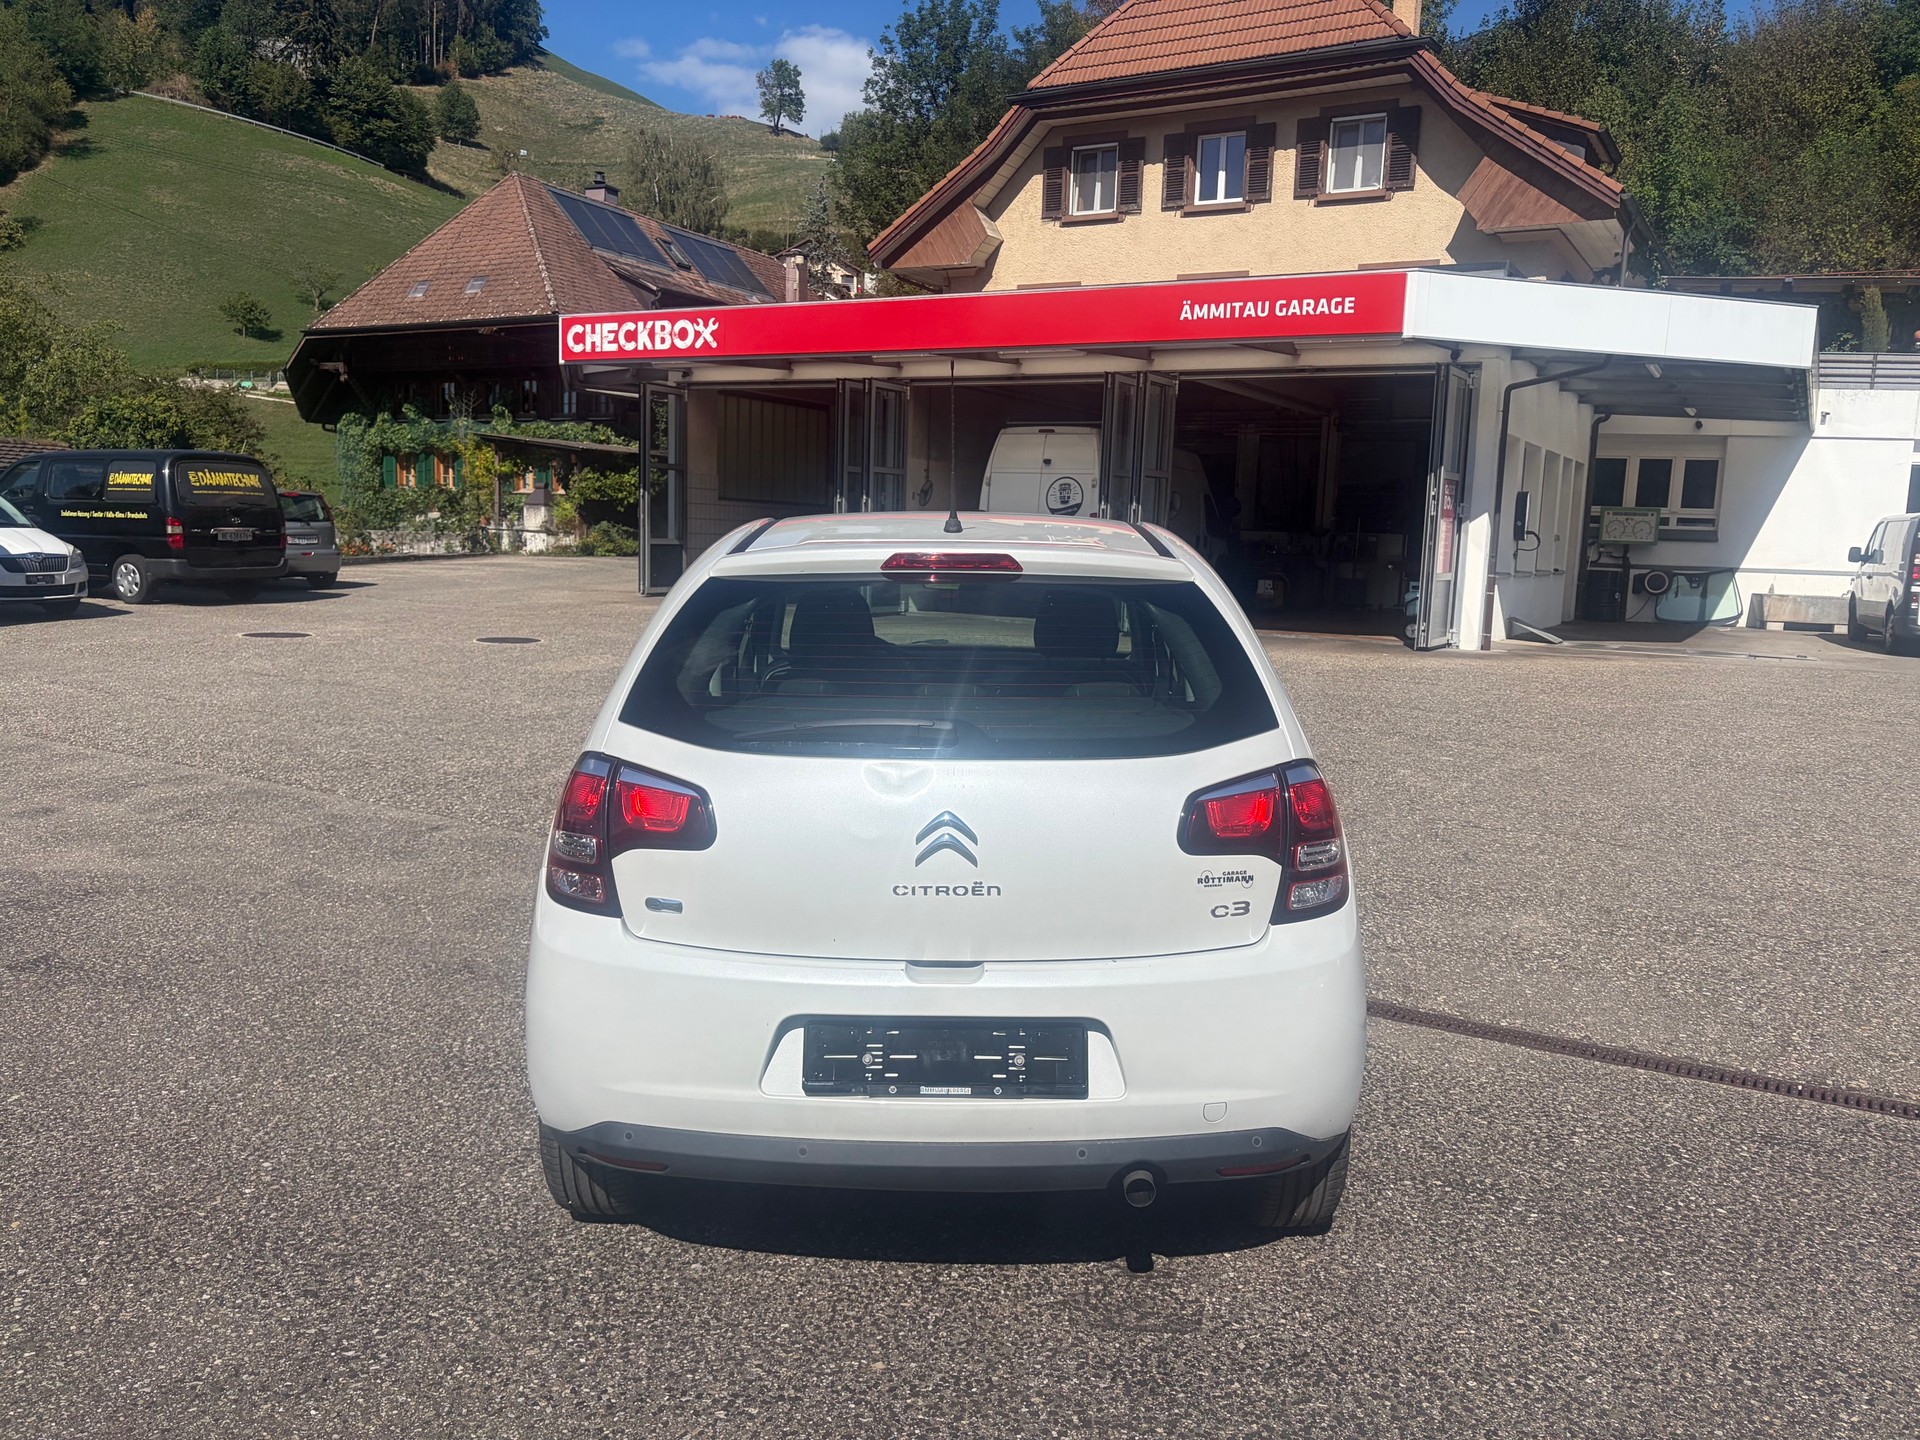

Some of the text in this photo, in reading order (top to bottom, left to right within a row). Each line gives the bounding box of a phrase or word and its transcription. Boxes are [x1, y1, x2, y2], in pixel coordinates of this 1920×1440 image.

[1179, 297, 1356, 321] ÄMMITAU GARAGE
[567, 317, 719, 353] CHECKBOX
[892, 880, 1002, 897] CITROËN
[1210, 900, 1251, 918] C3
